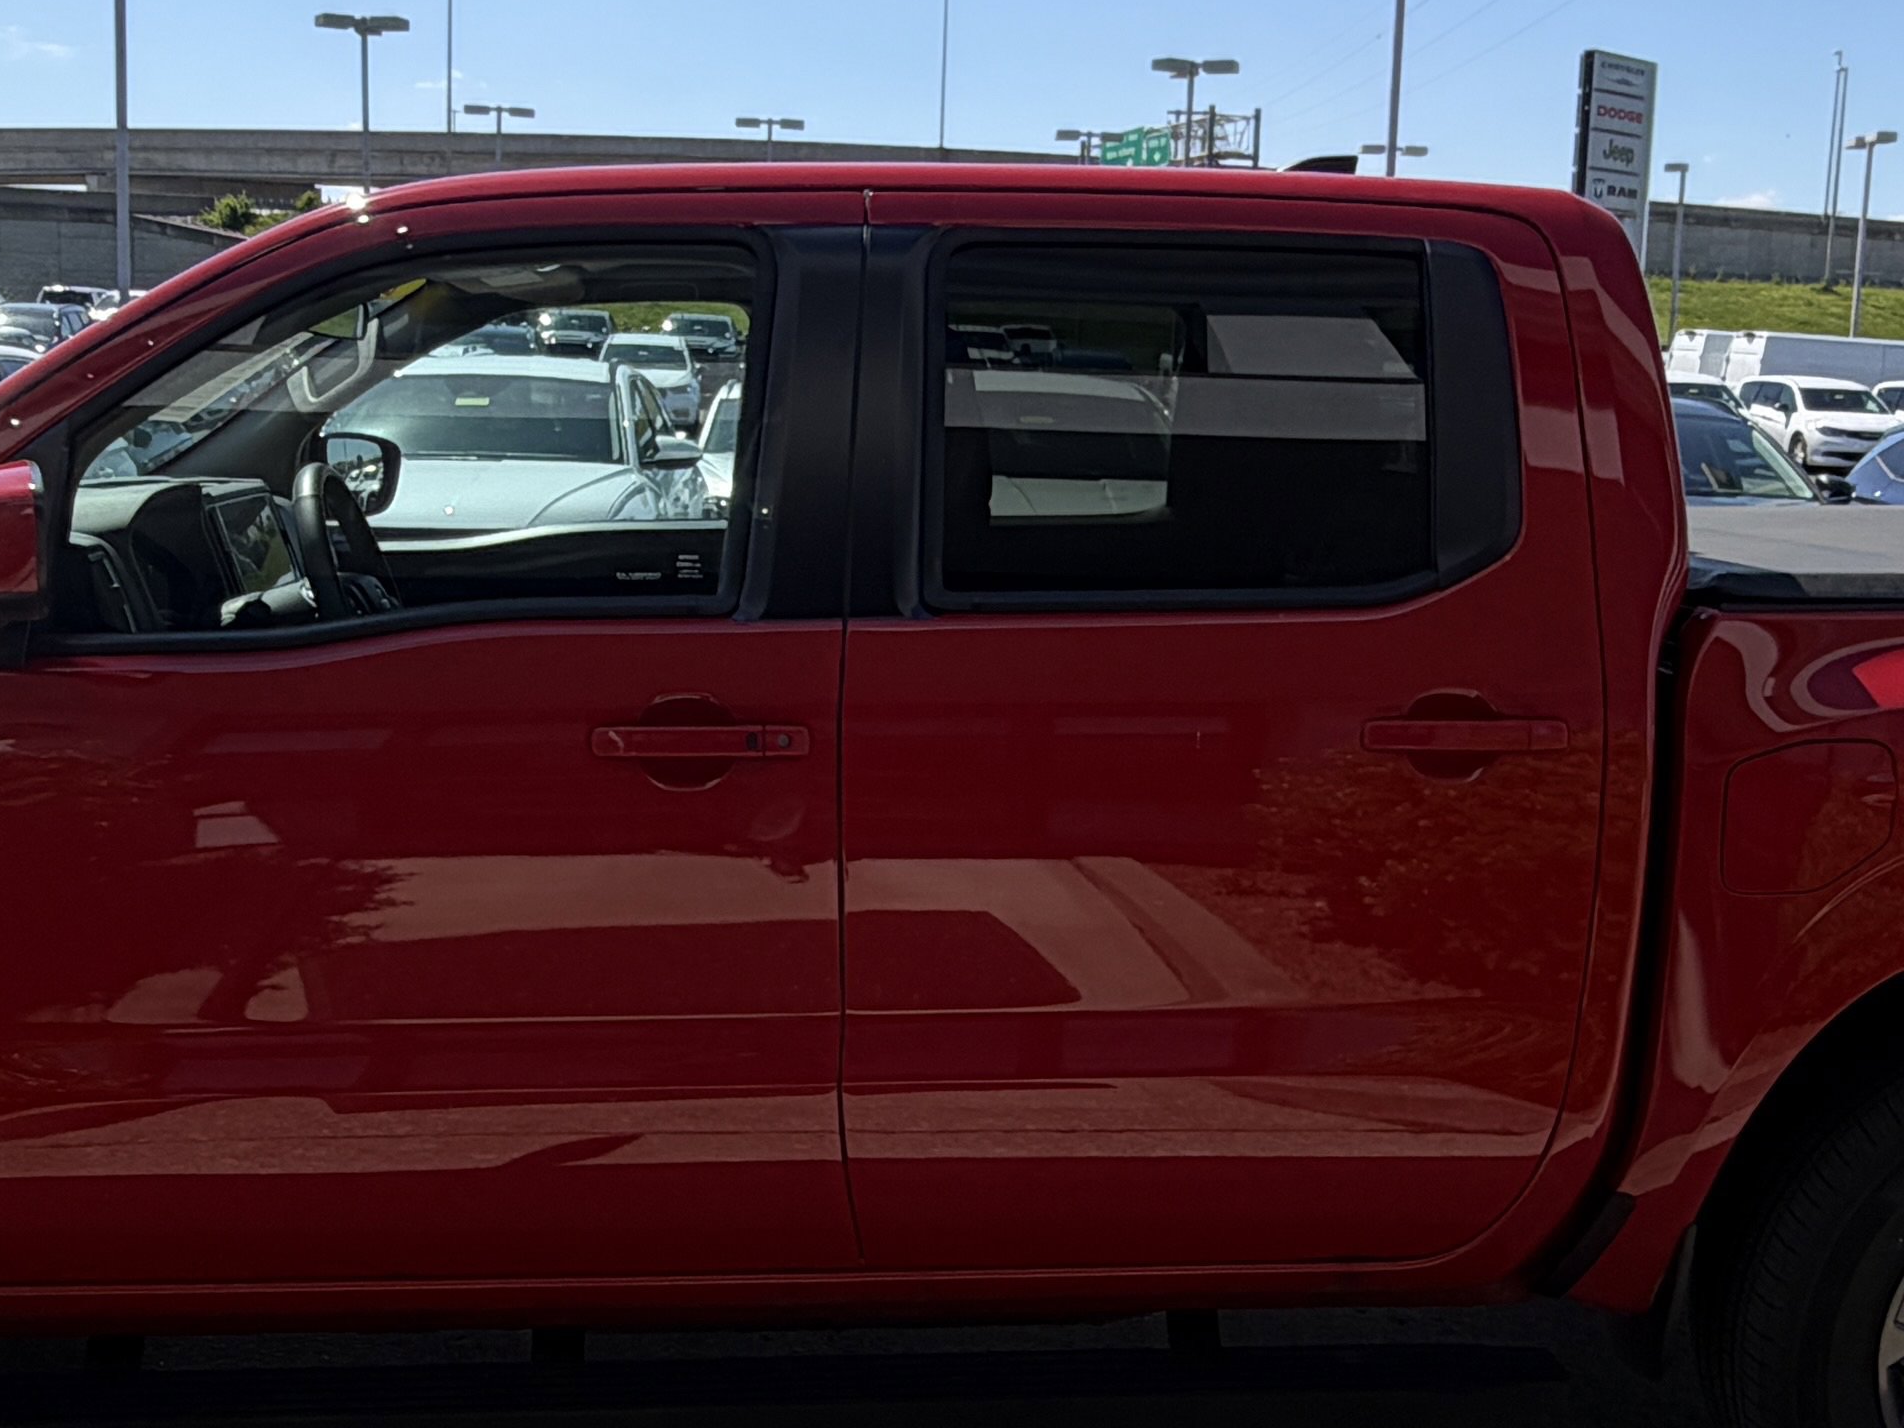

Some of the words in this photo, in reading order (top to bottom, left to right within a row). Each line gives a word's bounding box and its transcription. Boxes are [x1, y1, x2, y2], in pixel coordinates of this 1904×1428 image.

[1596, 104, 1644, 125] DODGE
[1602, 139, 1635, 166] Jeep
[1606, 184, 1638, 200] RAM
